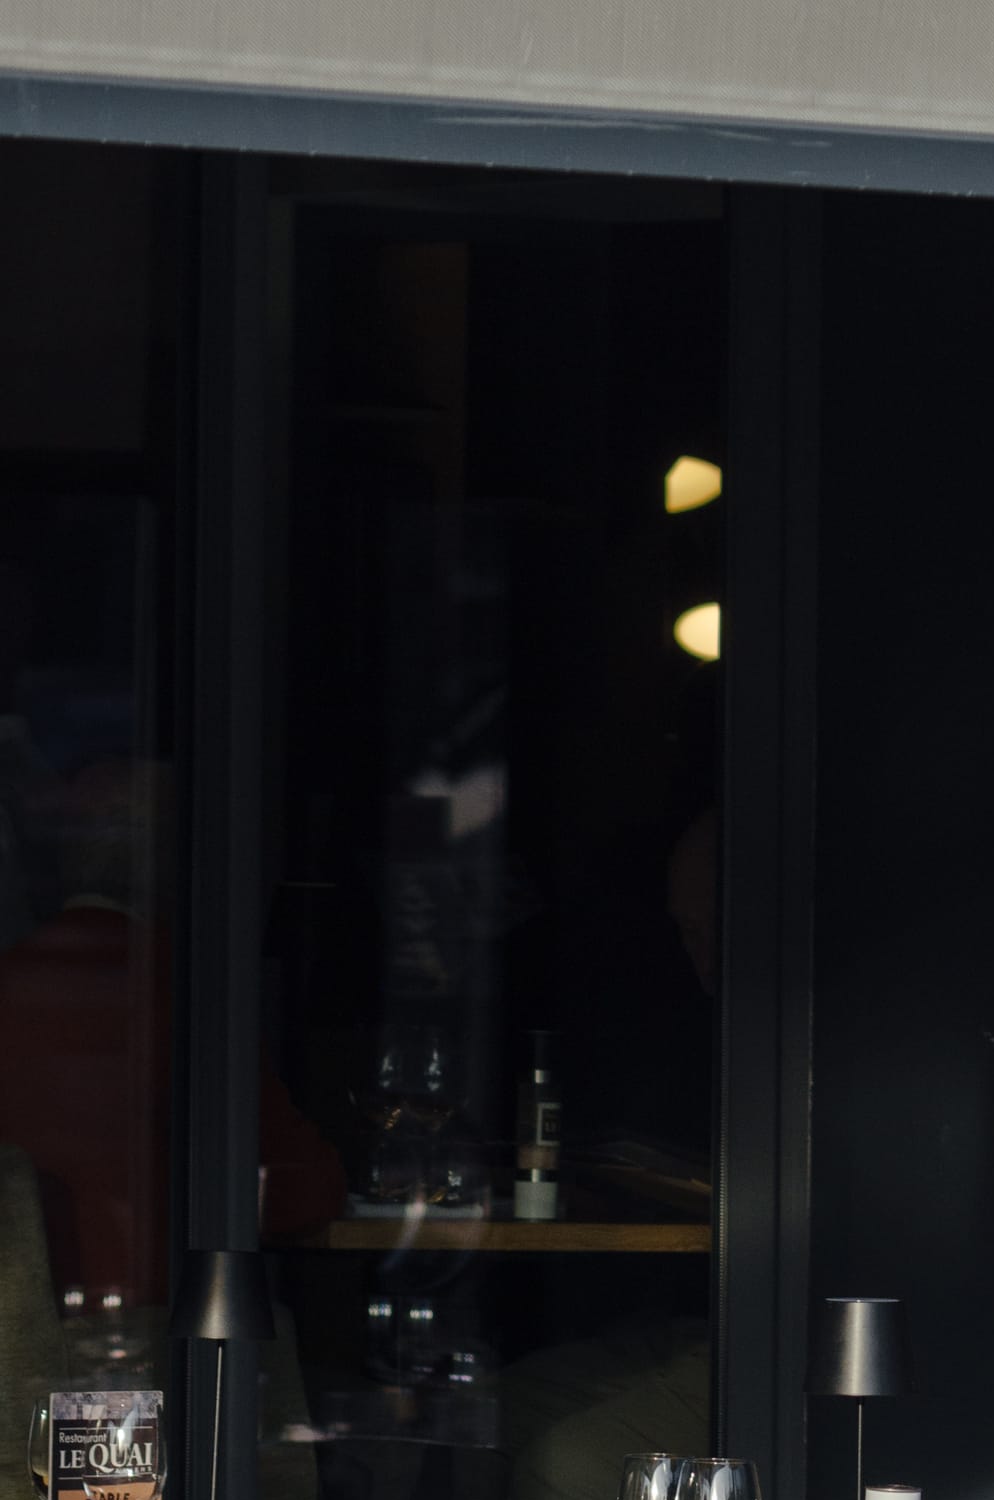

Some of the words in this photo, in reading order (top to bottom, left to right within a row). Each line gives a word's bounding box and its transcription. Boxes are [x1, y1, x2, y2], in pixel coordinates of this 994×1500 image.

[59, 1432, 107, 1444] Restaurant
[59, 1449, 86, 1469] LE
[88, 1442, 153, 1474] QUAI
